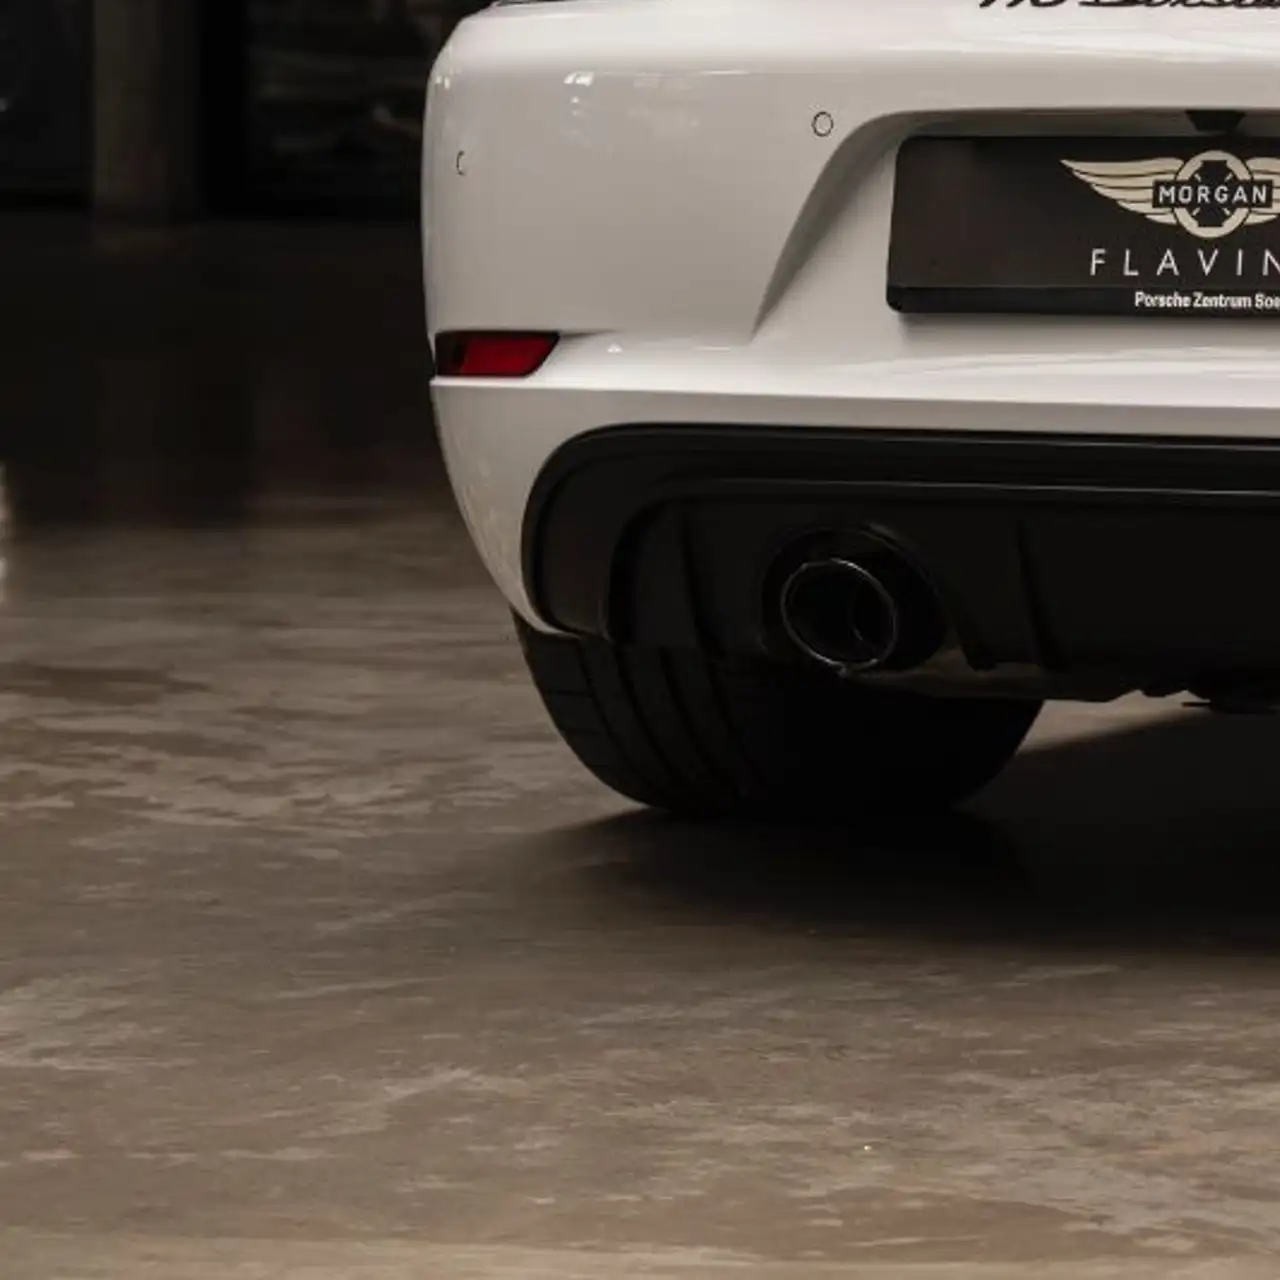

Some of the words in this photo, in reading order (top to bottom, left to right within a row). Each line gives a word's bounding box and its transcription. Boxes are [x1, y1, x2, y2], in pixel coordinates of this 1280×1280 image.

[1157, 183, 1268, 206] MORGAN
[1134, 291, 1191, 308] Porsche
[1193, 292, 1252, 309] Zentrum
